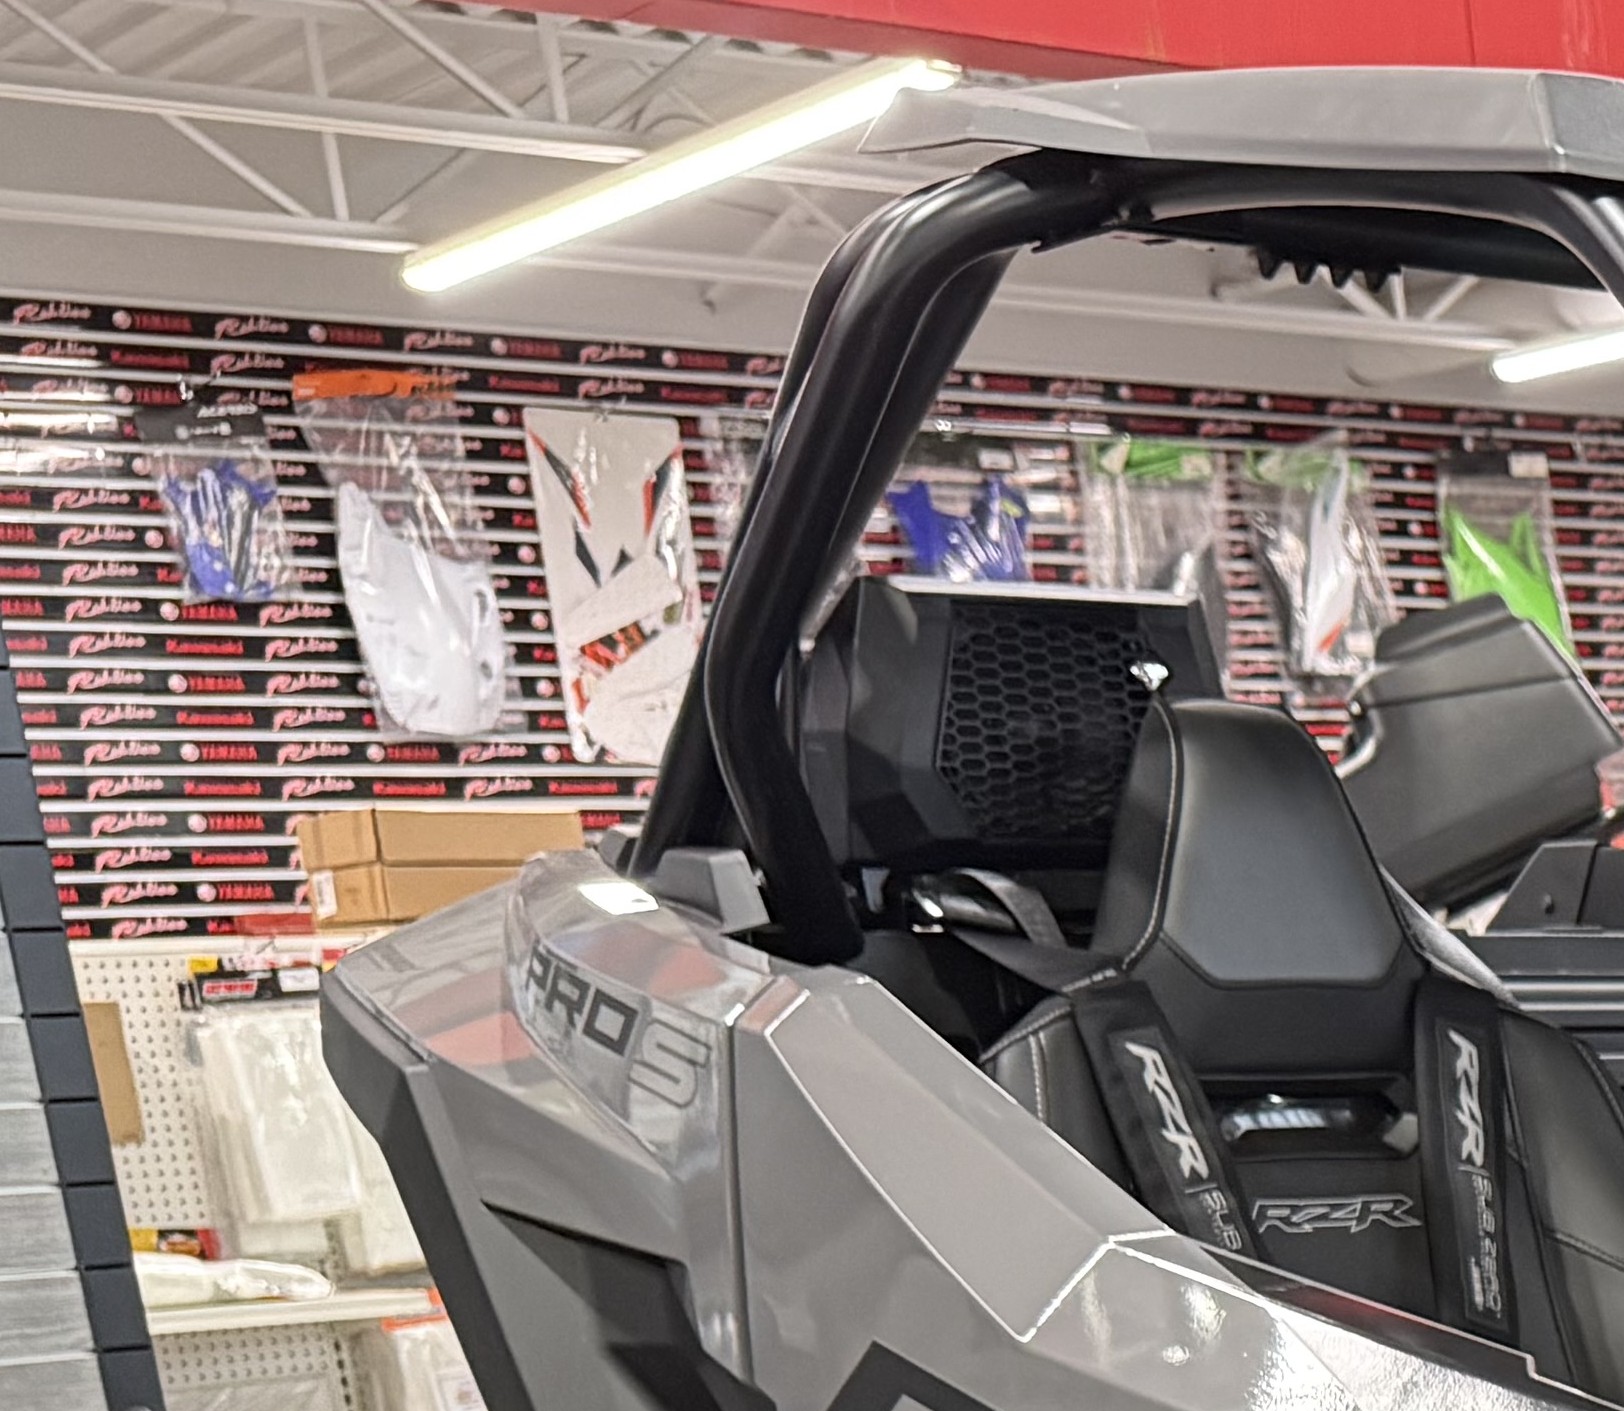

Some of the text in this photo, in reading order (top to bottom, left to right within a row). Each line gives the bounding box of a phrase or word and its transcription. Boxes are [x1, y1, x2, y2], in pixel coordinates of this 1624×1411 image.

[525, 943, 639, 1057] PRO
[1124, 1041, 1243, 1250] RZR SUB
[1448, 1028, 1485, 1168] RZR
[1252, 1193, 1422, 1234] RZR
